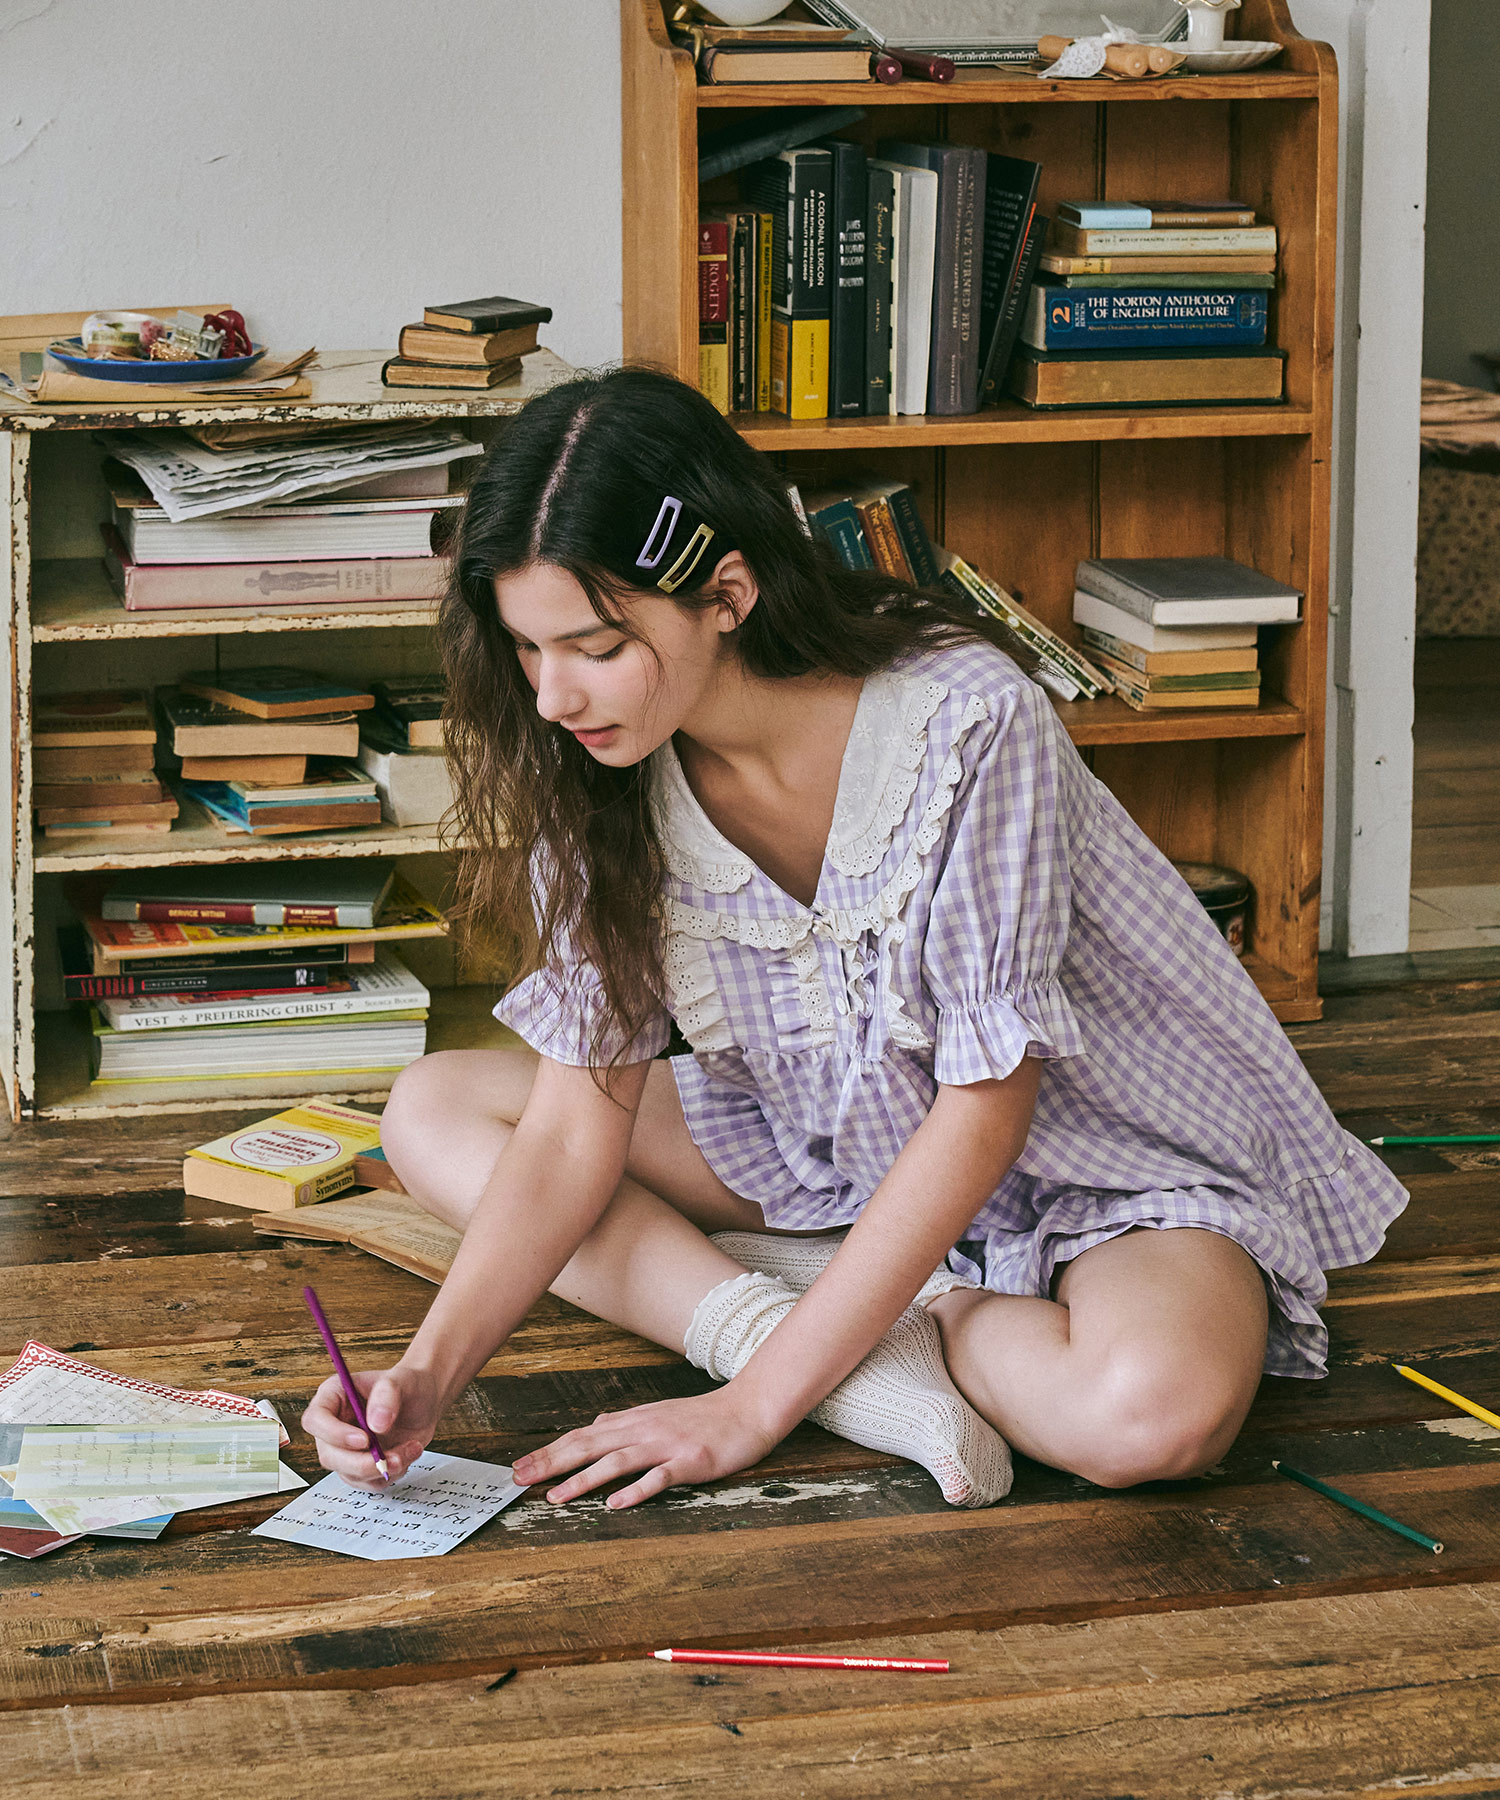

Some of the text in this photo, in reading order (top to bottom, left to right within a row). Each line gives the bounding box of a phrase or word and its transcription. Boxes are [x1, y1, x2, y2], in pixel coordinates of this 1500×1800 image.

[817, 200, 826, 245] COLONIAL
[816, 247, 825, 286] LEXICON
[962, 249, 973, 308] TURNED
[708, 263, 720, 319] ROGET'S
[1088, 294, 1236, 308] THE NORTON ANTHOLOGY
[1052, 306, 1071, 324] 2
[1093, 306, 1231, 319] OF ENGLISH LITERATURE
[961, 313, 970, 342] RED
[135, 1002, 337, 1027] VEST PREFERRING CHRIST
[315, 1175, 353, 1199] Synonyms
[425, 1529, 468, 1539] pour
[843, 1657, 868, 1667] Colored
[868, 1658, 888, 1668] Pencil
